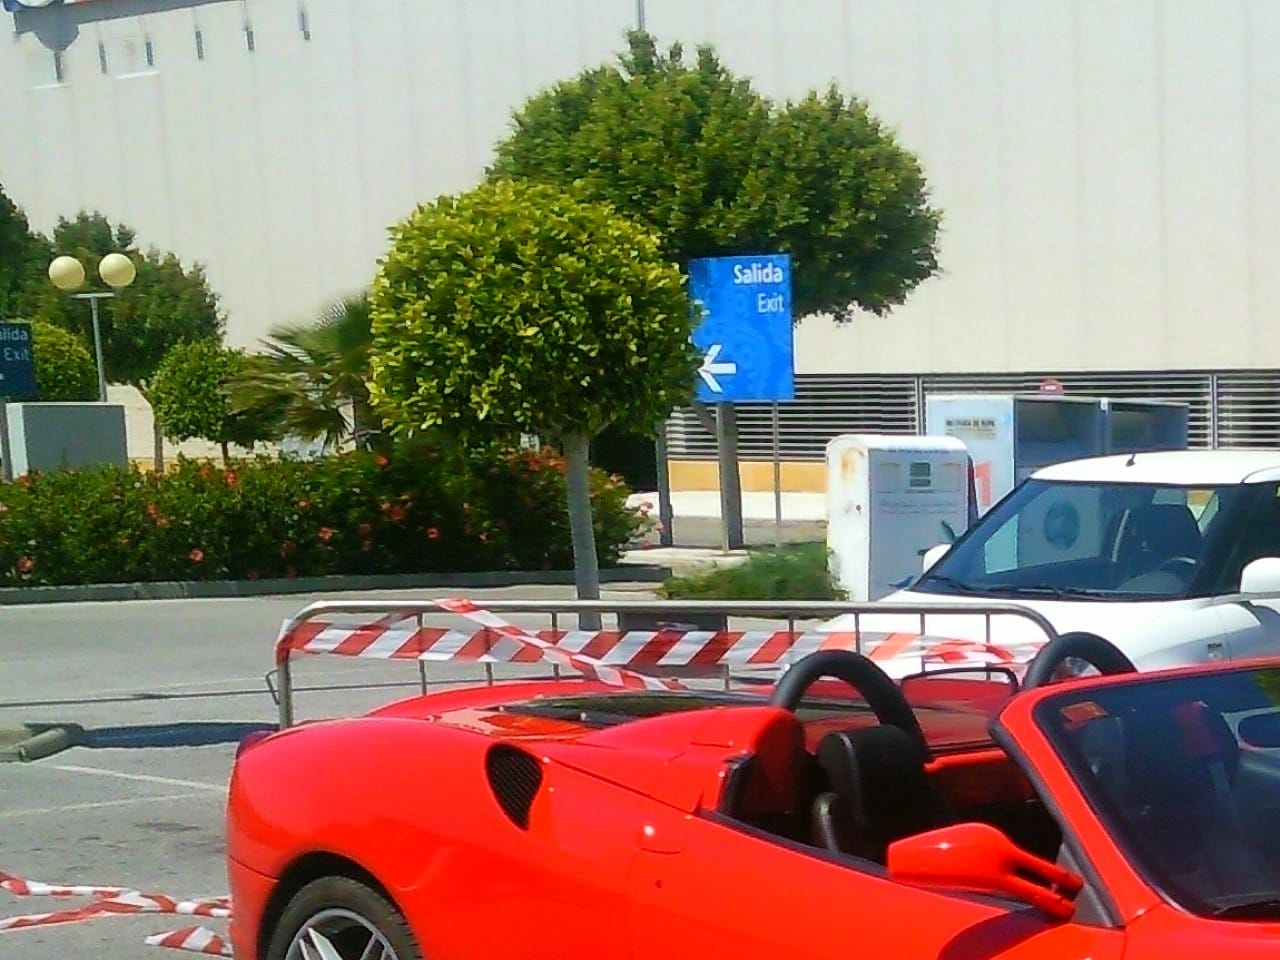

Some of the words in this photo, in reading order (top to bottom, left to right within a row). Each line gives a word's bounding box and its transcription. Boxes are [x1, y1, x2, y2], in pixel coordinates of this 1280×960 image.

[733, 262, 783, 284] Salida
[757, 292, 785, 313] Exit
[4, 347, 29, 361] Exit
